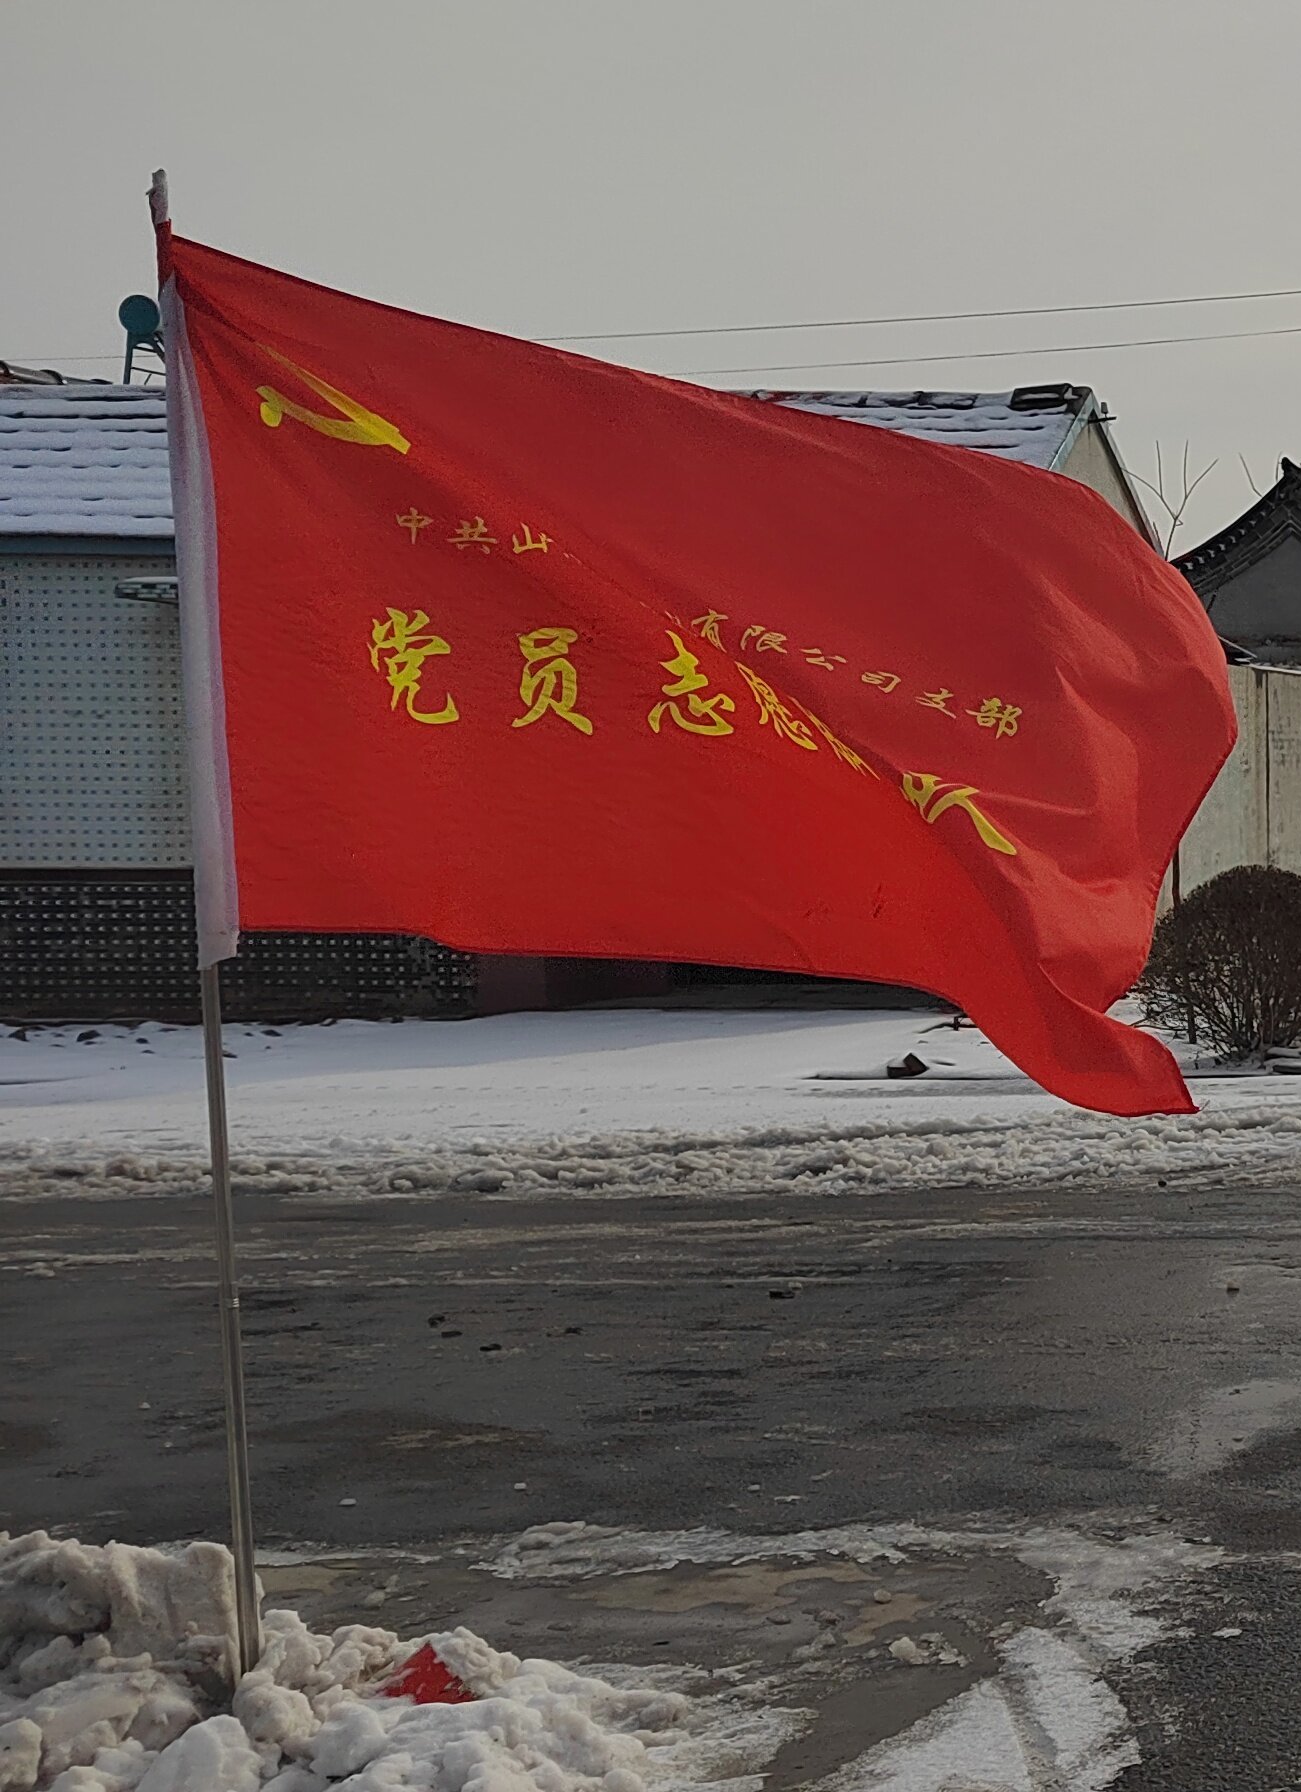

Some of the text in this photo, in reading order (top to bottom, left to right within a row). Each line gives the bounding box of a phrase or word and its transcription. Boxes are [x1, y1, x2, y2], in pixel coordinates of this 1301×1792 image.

[366, 606, 1018, 856] 党员志愿队
